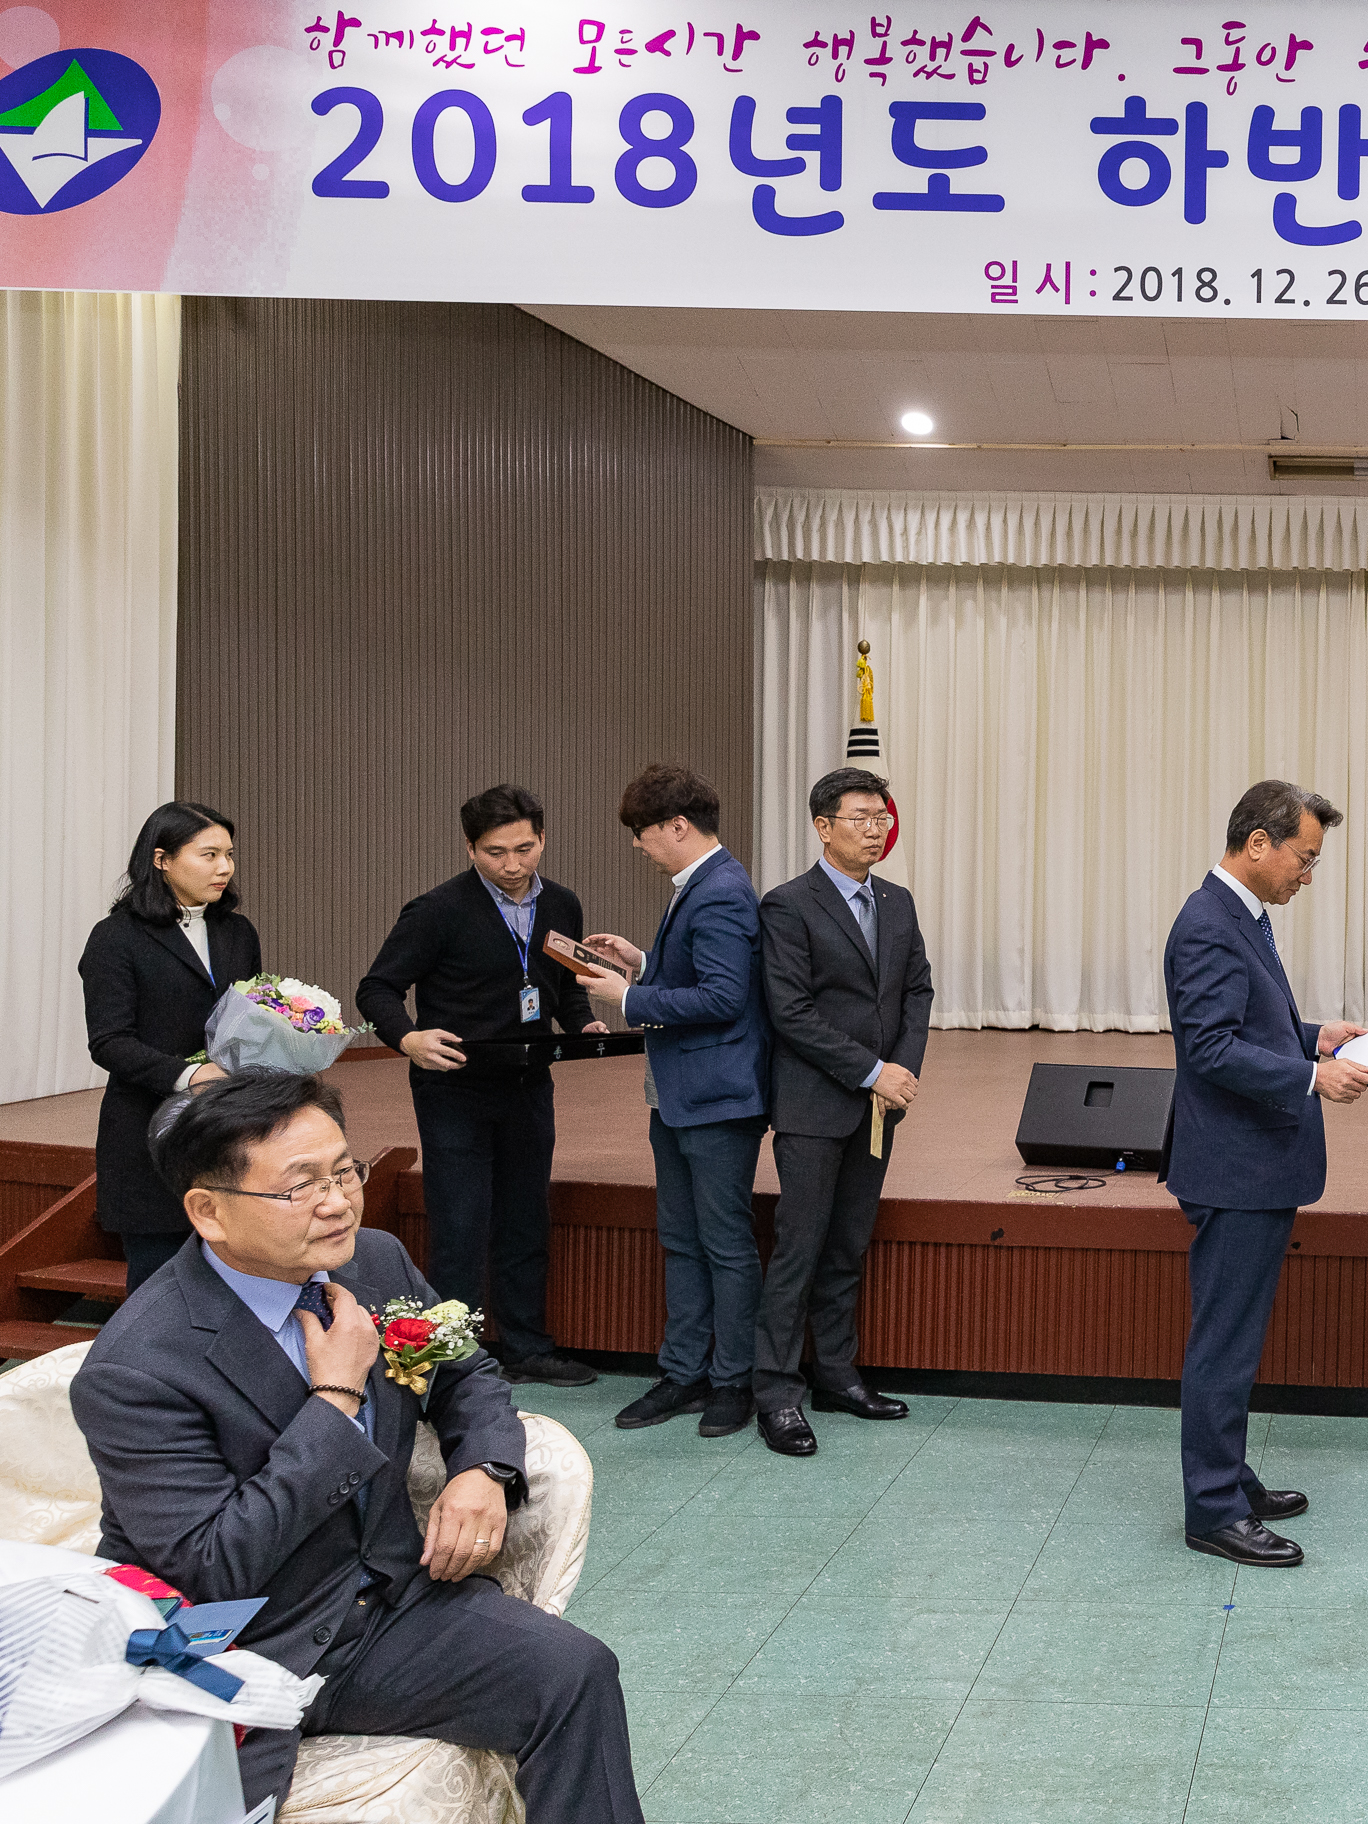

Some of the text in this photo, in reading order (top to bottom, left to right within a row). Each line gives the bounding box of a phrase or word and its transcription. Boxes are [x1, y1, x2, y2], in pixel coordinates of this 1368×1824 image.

[303, 10, 526, 70] 함께했던
[803, 16, 1126, 87] 행복했습니다.
[1172, 20, 1314, 97] 그동안
[311, 86, 1005, 237] 2018년도
